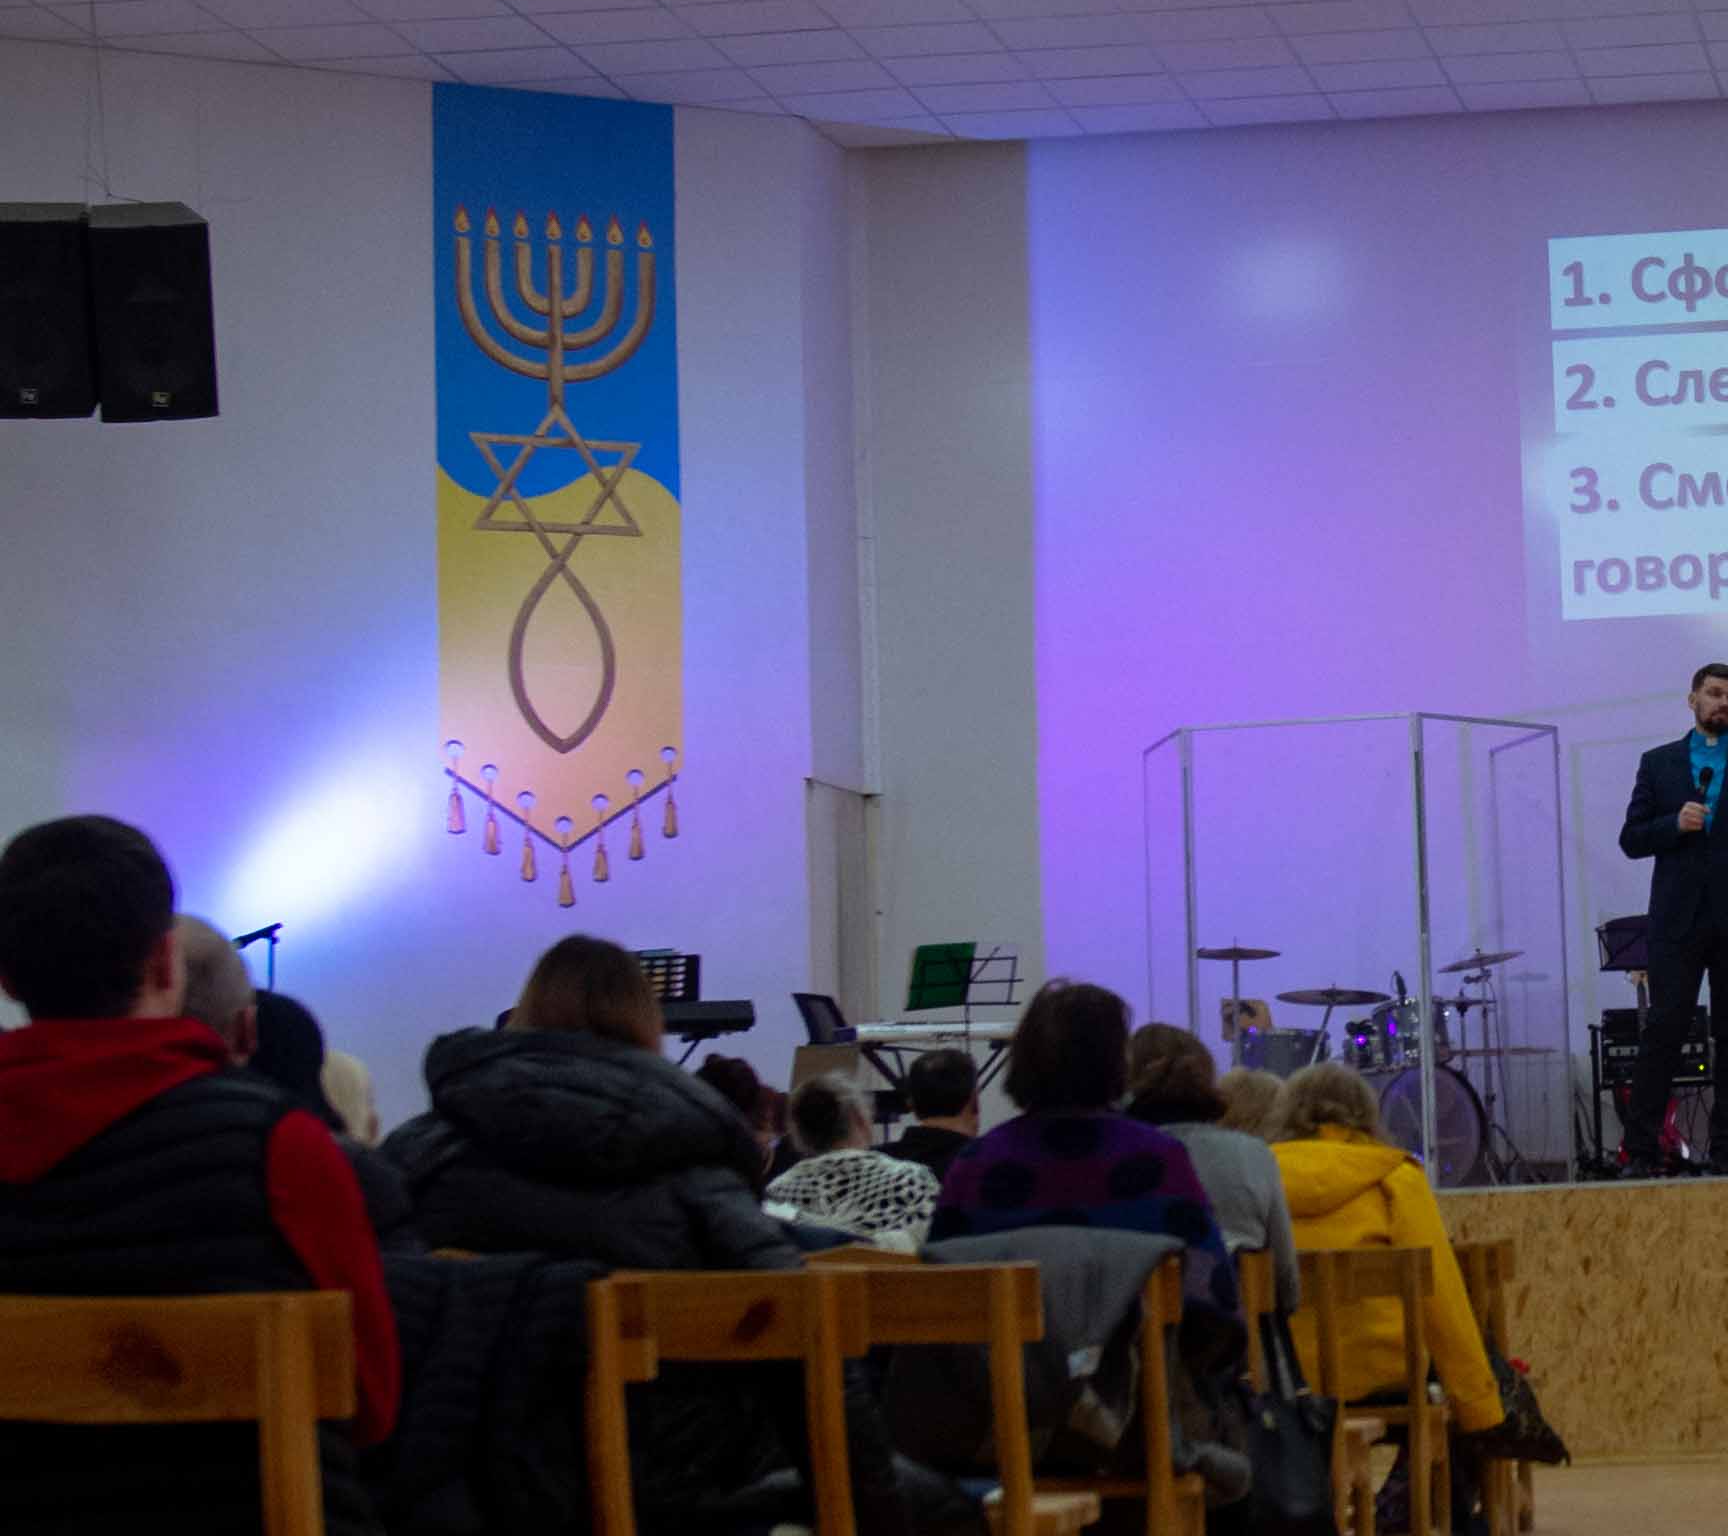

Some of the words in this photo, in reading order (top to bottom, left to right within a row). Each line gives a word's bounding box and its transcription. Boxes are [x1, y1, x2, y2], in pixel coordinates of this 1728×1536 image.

[1562, 260, 1613, 307] 1.
[1565, 363, 1616, 412] 2.
[1569, 466, 1620, 515] 3.
